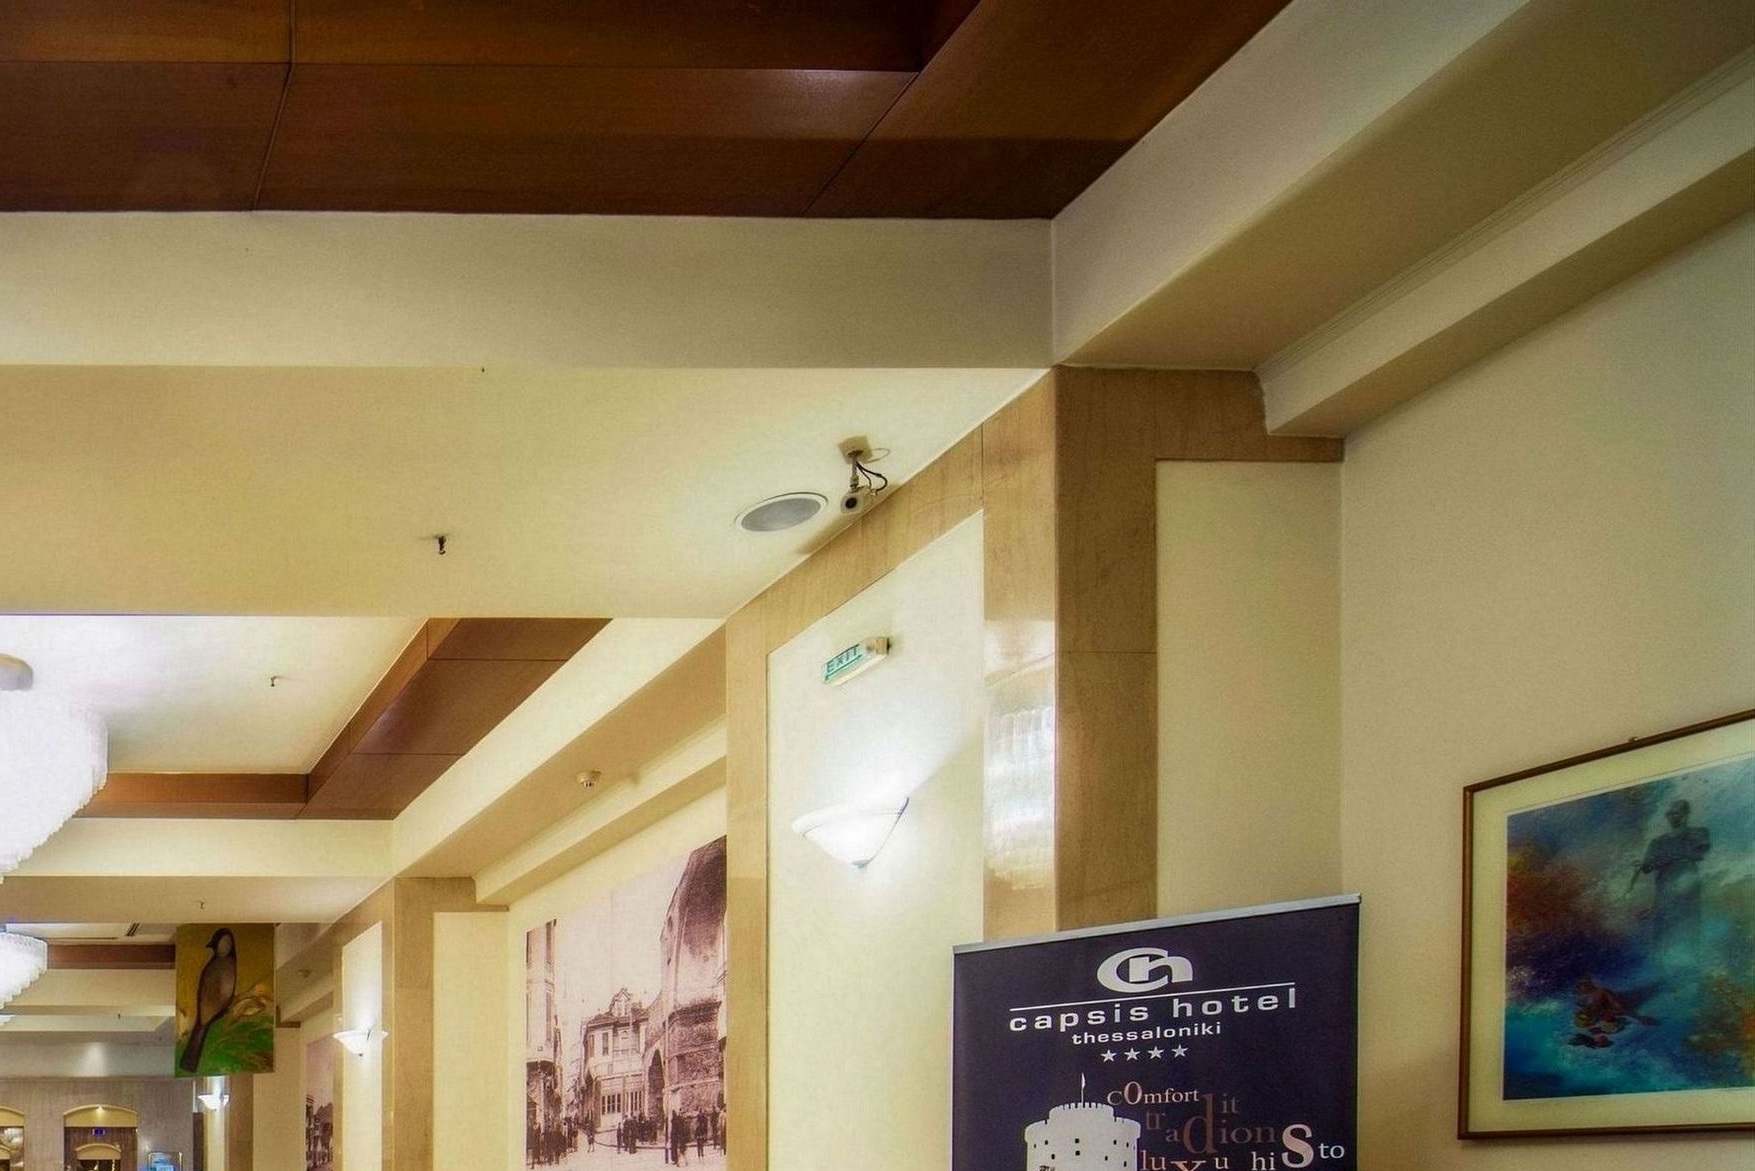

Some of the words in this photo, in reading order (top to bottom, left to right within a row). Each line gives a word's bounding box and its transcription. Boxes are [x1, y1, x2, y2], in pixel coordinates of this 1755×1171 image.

[1009, 1003, 1150, 1033] capsis
[1173, 988, 1296, 1018] hotel
[1072, 1022, 1222, 1046] thessaloniki
